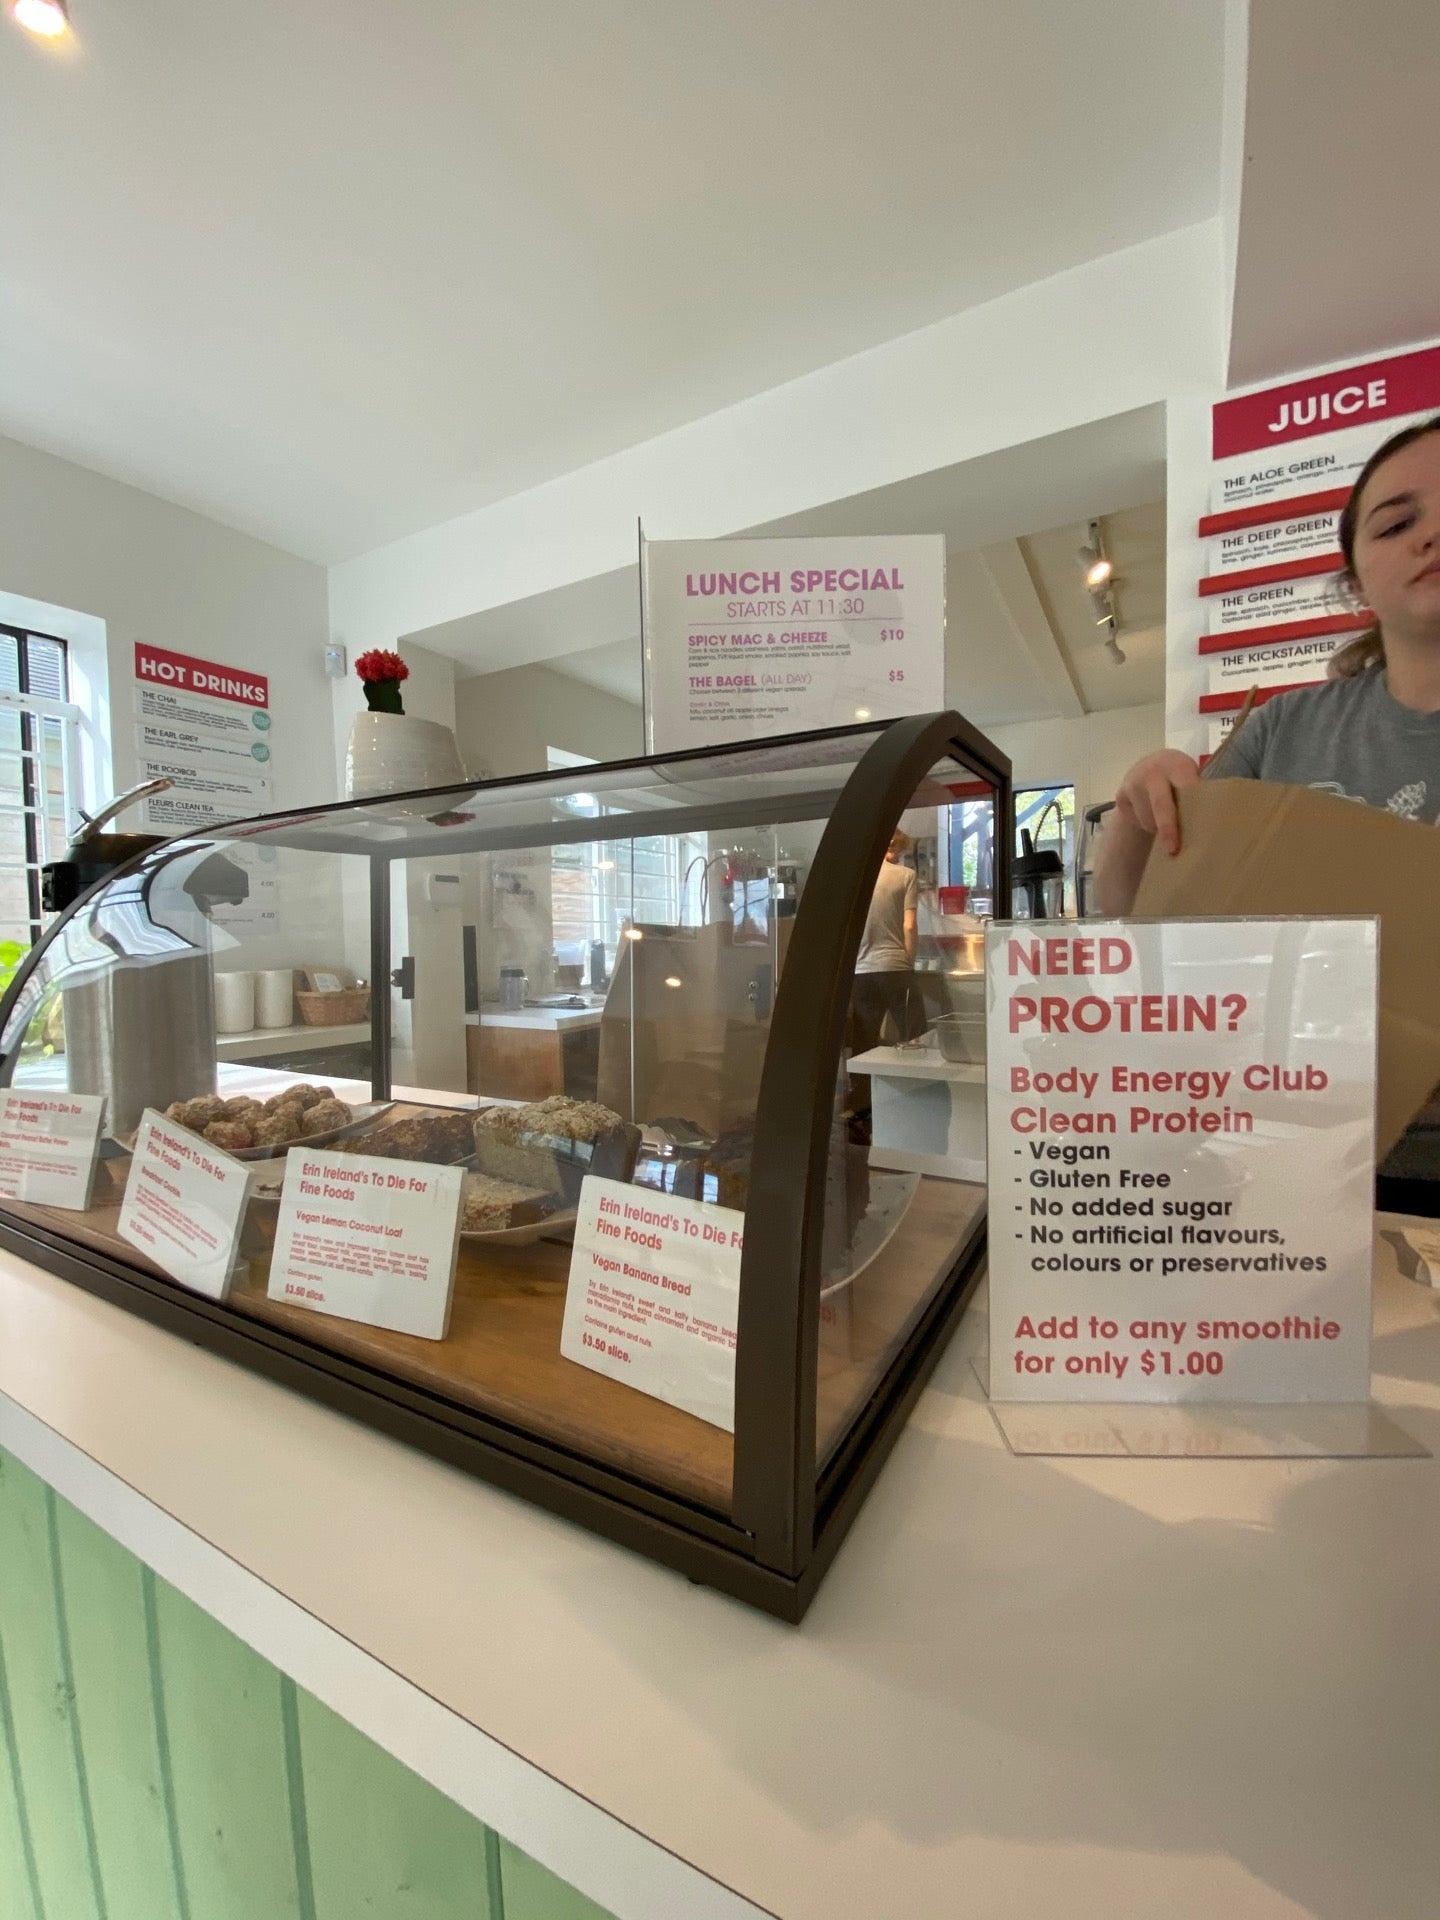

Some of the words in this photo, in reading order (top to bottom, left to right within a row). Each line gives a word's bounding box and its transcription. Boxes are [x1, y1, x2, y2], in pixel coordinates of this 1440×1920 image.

[1268, 379, 1387, 433] JUICE
[1224, 476, 1245, 489] THE
[1250, 467, 1284, 483] ALOE
[1288, 455, 1335, 474] GREEN
[1222, 536, 1244, 549] THE
[1248, 528, 1282, 543] DEEP
[1286, 518, 1332, 535] GREEN
[686, 571, 781, 597] LUNCH
[790, 568, 904, 593] SPECIAL
[726, 600, 786, 618] STARTS
[791, 599, 811, 616] AT
[817, 598, 864, 615] 11:30
[1222, 595, 1243, 608] THE
[1248, 586, 1294, 603] GREEN
[688, 634, 726, 647] SPICY
[731, 634, 762, 646] MAC
[766, 633, 776, 644] &
[780, 632, 828, 644] CHEEZE
[880, 629, 904, 641] $10
[1222, 654, 1244, 667] THE
[1248, 641, 1336, 663] KICKSTARTER
[140, 658, 187, 682] HOT
[192, 670, 265, 703] DRINKS
[689, 676, 712, 688] THE
[716, 674, 757, 687] BAGEL
[761, 674, 784, 686] (ALL
[786, 672, 812, 684] DAY)
[888, 670, 904, 682] $5
[142, 690, 156, 700] THE
[158, 694, 176, 704] CHAI
[144, 727, 158, 736] THE
[160, 729, 177, 740] EARL
[178, 733, 198, 742] GREY
[1221, 718, 1235, 727] TH
[146, 763, 160, 772] THE
[162, 766, 197, 776] ROOIBOS
[148, 799, 174, 808] FLEURS
[176, 802, 200, 811] CLEAN
[1007, 937, 1132, 976] NEED
[1008, 993, 1248, 1034] PROTEIN?
[1011, 1066, 1099, 1099] Body
[1111, 1064, 1231, 1100] Energy
[1243, 1062, 1329, 1093] Club
[1010, 1106, 1117, 1135] Clean
[1131, 1106, 1254, 1135] Protein
[193, 1151, 200, 1166] To
[202, 1158, 213, 1174] Die
[214, 1166, 226, 1182] For
[1029, 1141, 1110, 1164] Vegan
[300, 1180, 320, 1196] Fine
[323, 1184, 355, 1201] Foods
[302, 1163, 320, 1176] Erin
[324, 1166, 368, 1184] Ireland's
[372, 1172, 384, 1186] To
[388, 1174, 406, 1190] Die
[409, 1177, 428, 1193] For
[1029, 1170, 1110, 1189] Gluten
[1120, 1170, 1171, 1189] Free
[600, 1196, 620, 1216] Erin
[624, 1202, 679, 1232] Ireland's
[684, 1218, 699, 1238] To
[703, 1223, 726, 1245] Die
[1030, 1198, 1064, 1218] No
[1071, 1197, 1155, 1218] added
[1162, 1199, 1233, 1222] sugar
[296, 1210, 320, 1224] Vegan
[322, 1214, 348, 1228] Lemon
[350, 1220, 383, 1235] Coconut
[385, 1225, 404, 1238] Loaf
[596, 1218, 620, 1238] Fine
[624, 1226, 662, 1251] Foods
[1030, 1226, 1064, 1246] No
[1071, 1225, 1173, 1245] artificial
[1182, 1225, 1285, 1247] flavours,
[592, 1253, 621, 1274] Vegan
[624, 1263, 660, 1287] Banana
[662, 1276, 692, 1296] Bread
[1030, 1254, 1121, 1274] colours
[1129, 1257, 1154, 1273] or
[1162, 1252, 1327, 1276] preservatives
[585, 1314, 608, 1330] Contains
[609, 1324, 626, 1337] gluten
[627, 1332, 638, 1342] and
[638, 1307, 652, 1318] extra
[687, 1324, 700, 1334] and
[702, 1330, 726, 1345] organic
[659, 1305, 671, 1315] and
[675, 1311, 688, 1322] salty
[693, 1316, 718, 1332] banana
[1014, 1316, 1079, 1340] Add
[1089, 1316, 1120, 1340] to
[1129, 1319, 1186, 1345] any
[1196, 1315, 1341, 1340] smoothie
[582, 1332, 606, 1352] $3.50
[608, 1344, 632, 1363] slice.
[1014, 1350, 1056, 1375] for
[1065, 1350, 1129, 1378] only
[1140, 1350, 1223, 1376] $1.00
